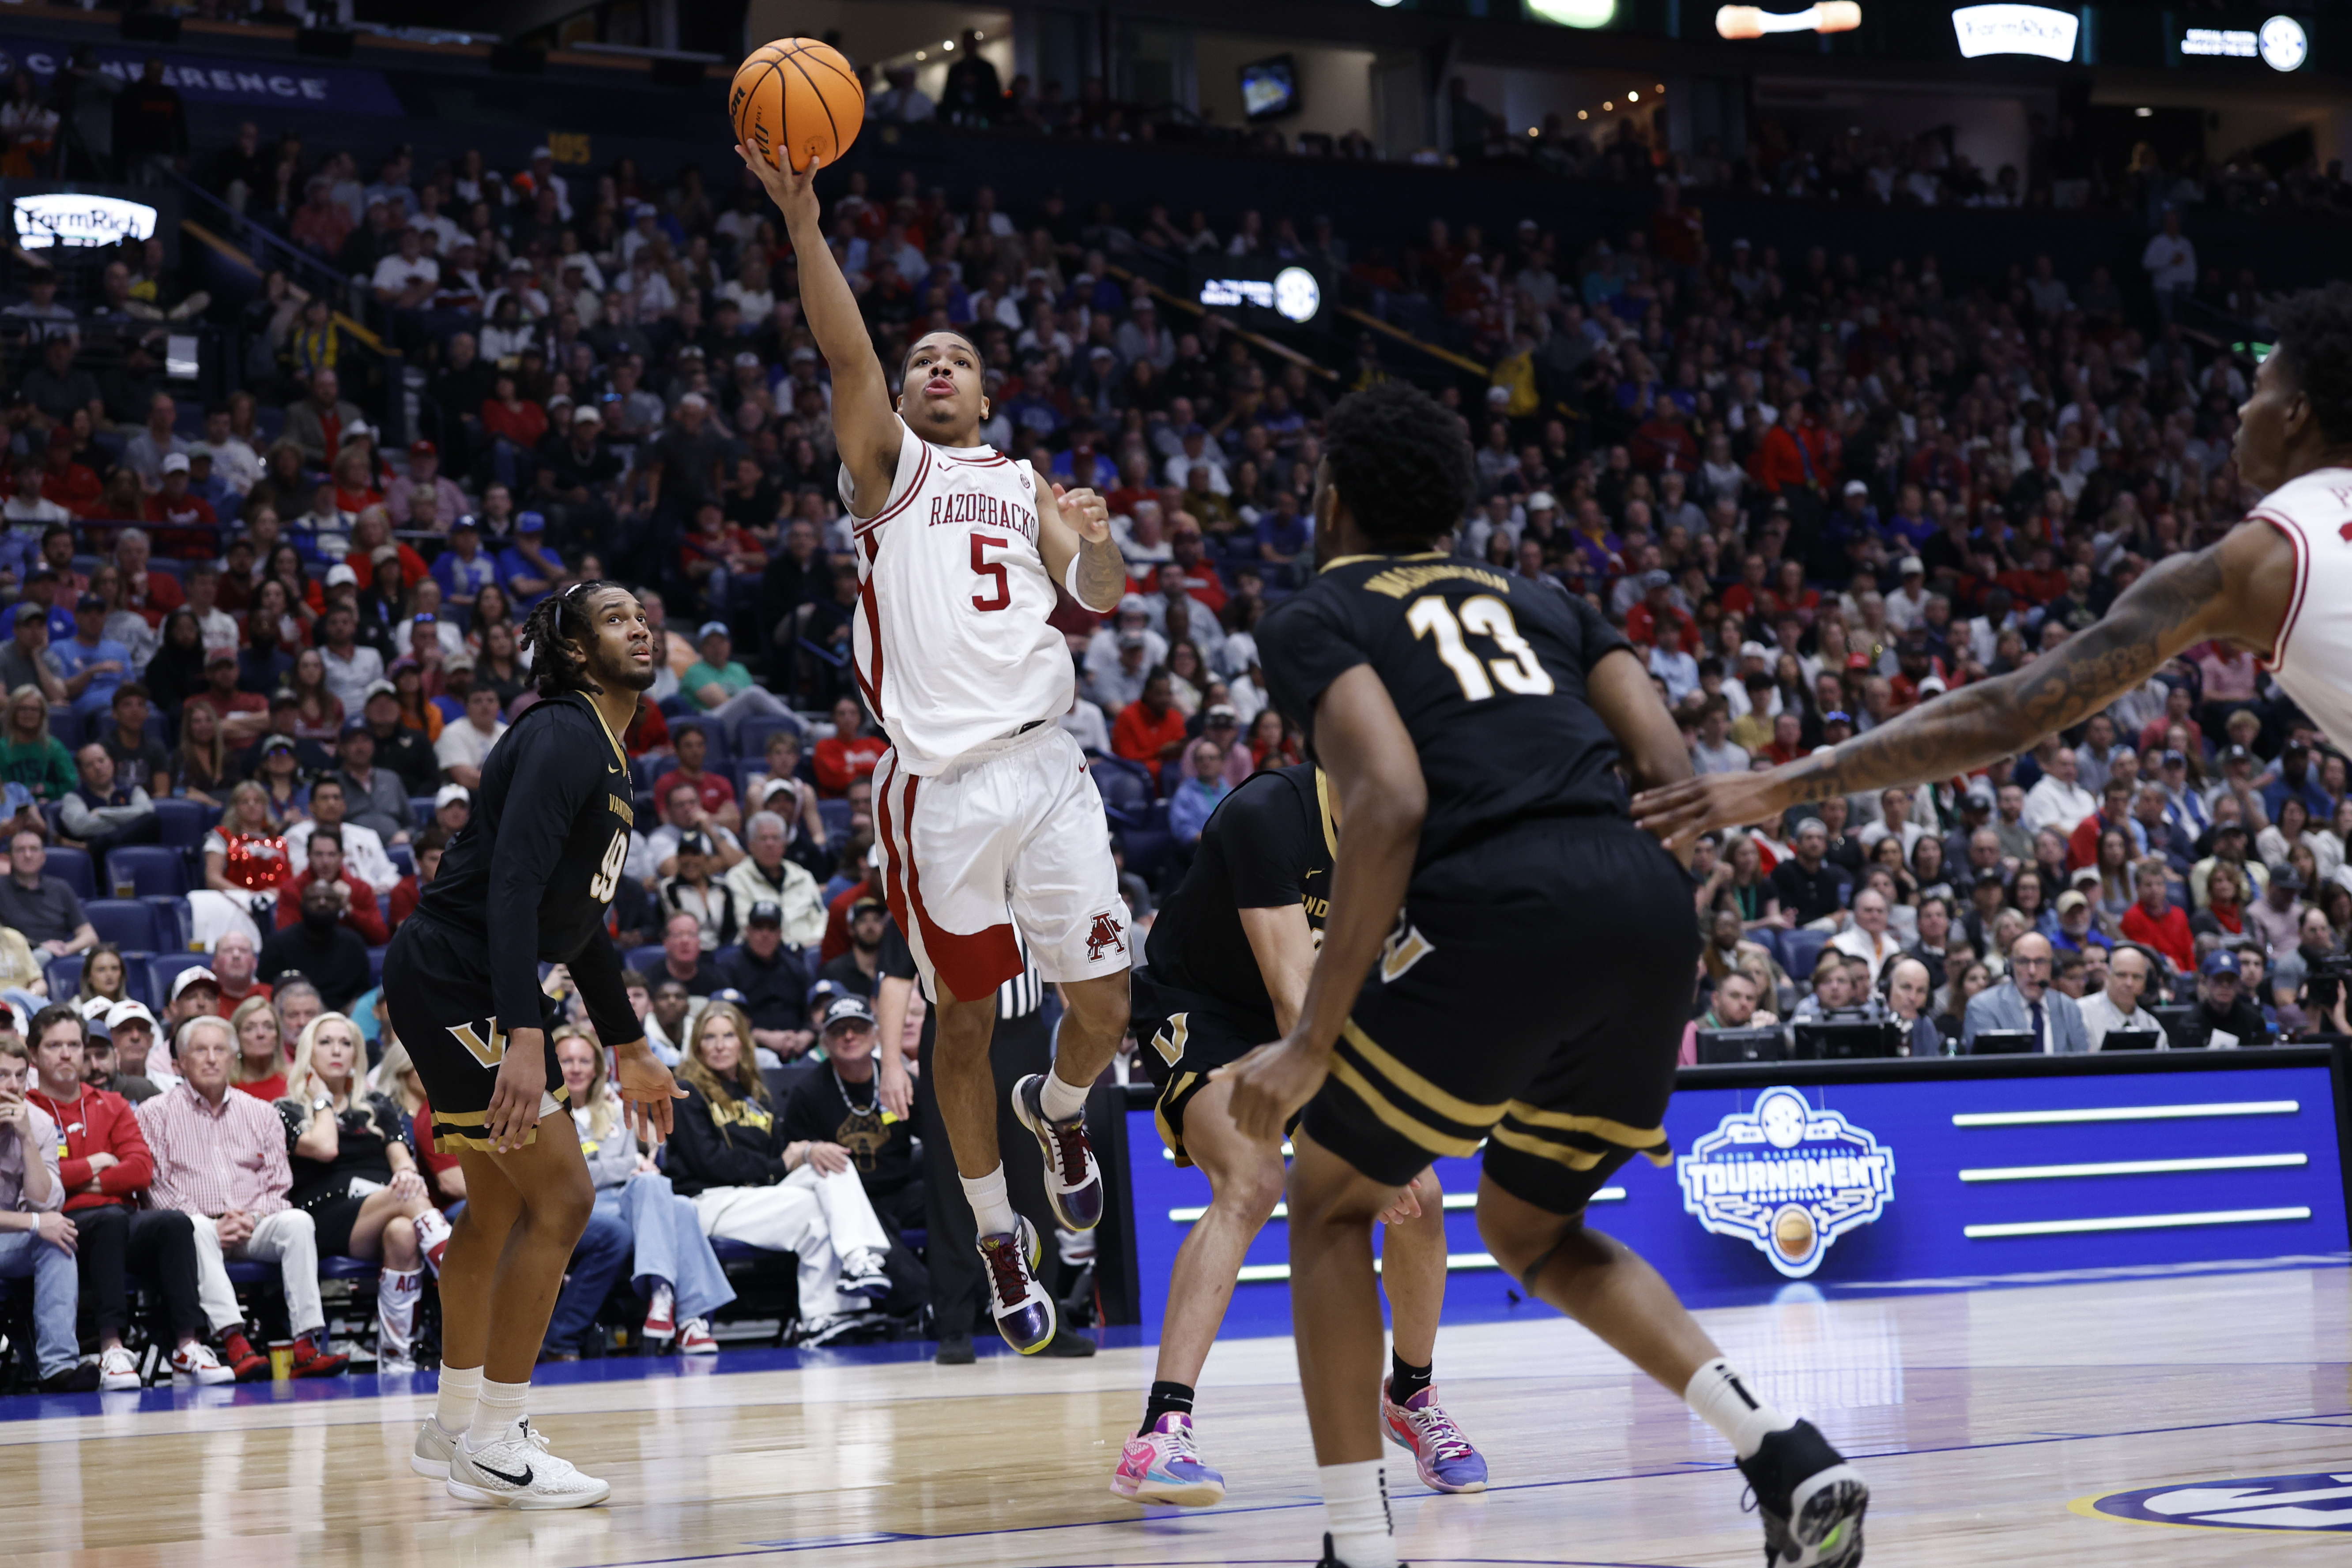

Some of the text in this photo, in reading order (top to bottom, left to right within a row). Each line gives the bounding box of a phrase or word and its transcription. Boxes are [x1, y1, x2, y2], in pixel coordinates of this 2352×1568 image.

[929, 493, 1035, 548] RAZORBACKS
[970, 533, 1011, 612] 5
[1405, 594, 1555, 701] 13
[590, 827, 629, 905] 99
[1150, 1012, 1190, 1068] V
[1685, 1156, 1886, 1202] TOURNAMENT
